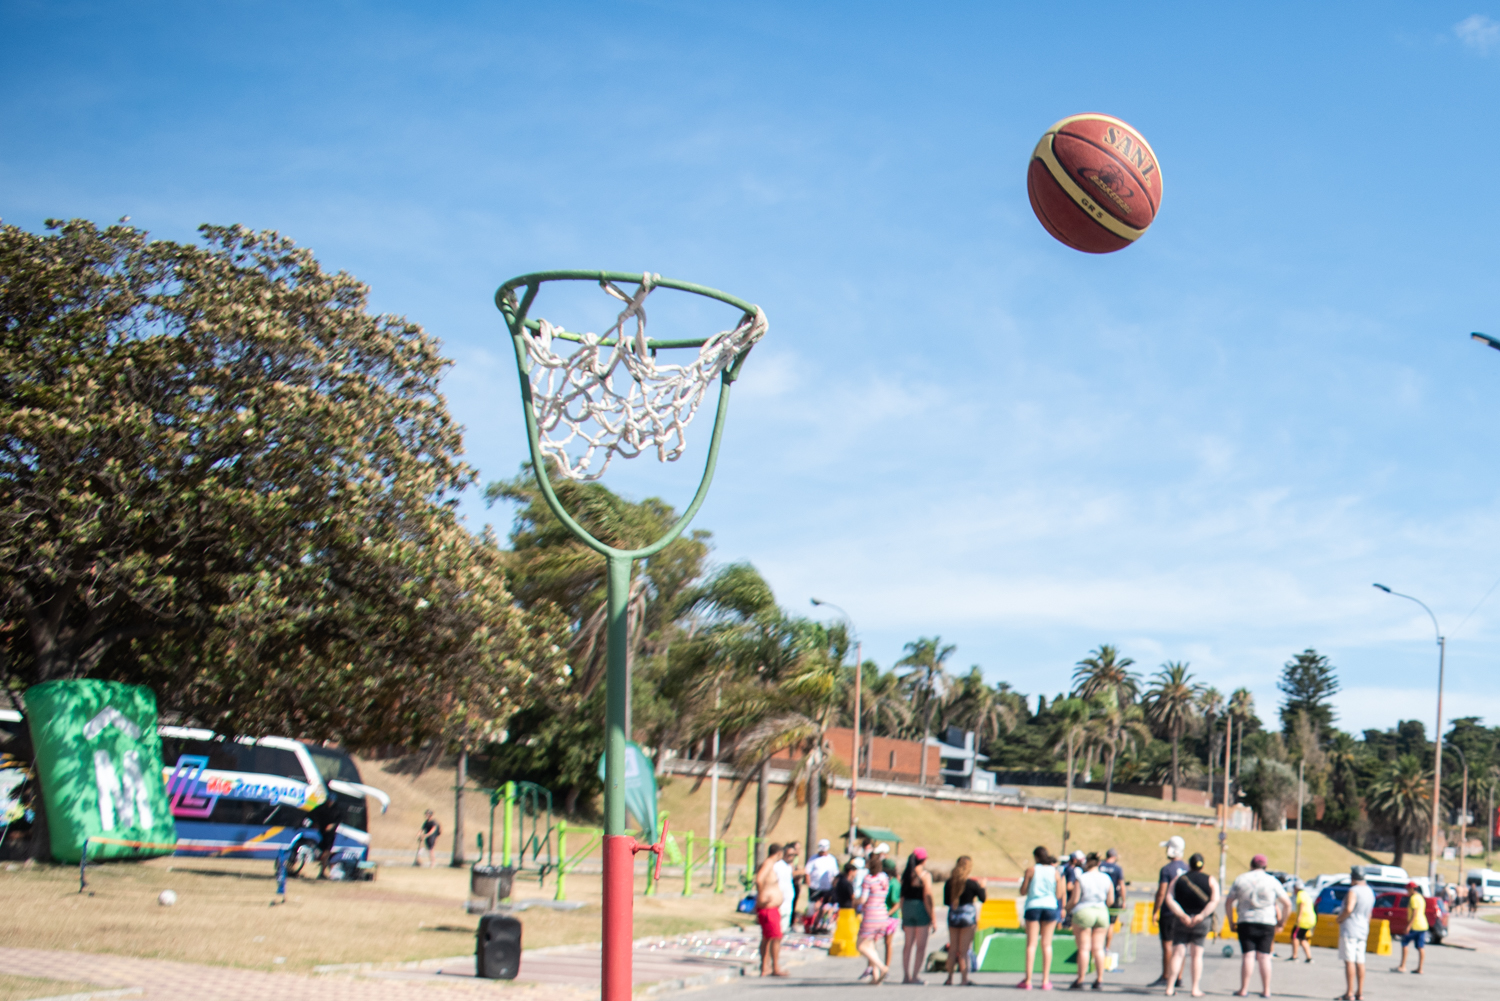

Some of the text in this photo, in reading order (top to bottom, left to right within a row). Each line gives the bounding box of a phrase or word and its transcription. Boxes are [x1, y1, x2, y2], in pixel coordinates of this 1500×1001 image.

[1081, 198, 1104, 219] GR 5
[234, 778, 306, 808] Paraguay
